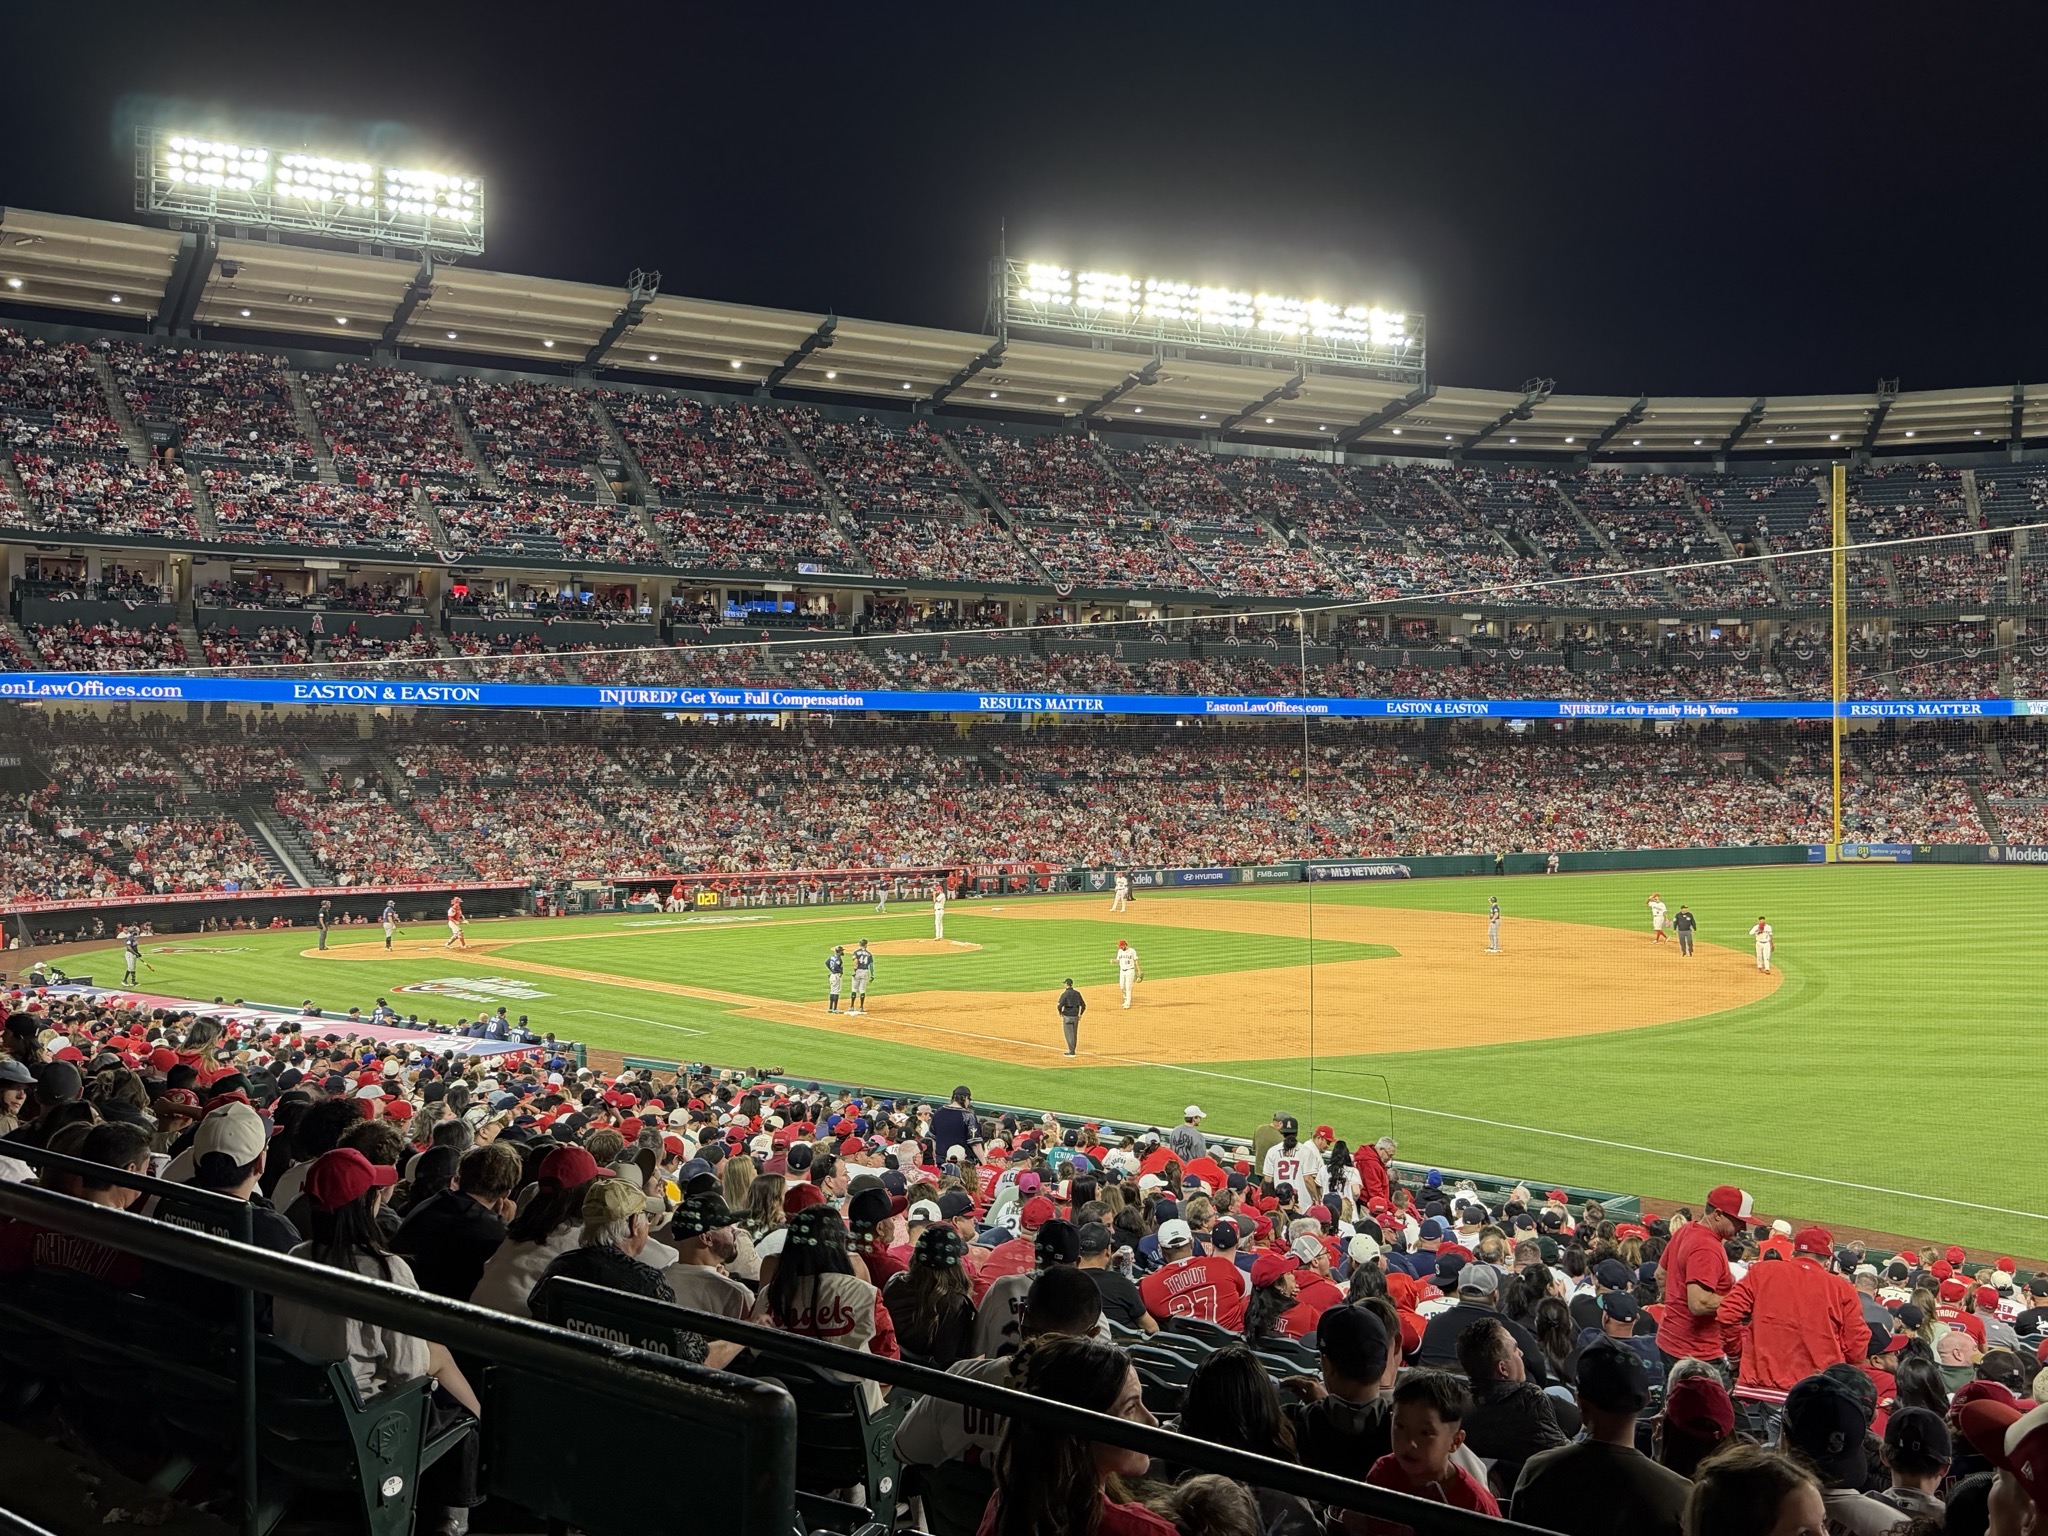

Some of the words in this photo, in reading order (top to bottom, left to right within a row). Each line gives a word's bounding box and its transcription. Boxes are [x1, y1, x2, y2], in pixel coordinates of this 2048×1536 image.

[293, 684, 378, 699] EASTON
[382, 686, 396, 699] &
[400, 686, 480, 701] EASTON
[598, 689, 678, 706] INJURED?
[680, 691, 706, 704] Get
[708, 692, 742, 704] Your
[743, 692, 770, 705] Full
[772, 695, 864, 708] Compensation
[979, 697, 1042, 710] RESULTS
[1045, 698, 1104, 710] MATTER
[1206, 701, 1328, 713] EastonLawOffices.com
[1386, 702, 1432, 713] EASTON
[1434, 703, 1443, 714] &
[1444, 703, 1489, 714] EASTON
[1850, 704, 1915, 715] RESULTS
[1918, 704, 1983, 715] MATTER
[1558, 704, 1609, 716] INJURED?
[1610, 704, 1626, 715] Let
[1627, 705, 1646, 715] Our
[1647, 704, 1682, 717] Family
[1683, 704, 1708, 717] Help
[1709, 704, 1739, 715] Yours
[1857, 846, 1869, 855] 811
[1919, 845, 1931, 854] 347
[2005, 846, 2048, 862] Modelo
[1195, 872, 1224, 880] HYUNDAI
[1331, 867, 1351, 878] MLB
[1351, 865, 1396, 877] NETWORK
[1053, 1151, 1075, 1161] ICHIRO
[1277, 1160, 1300, 1181] 27
[1163, 1266, 1208, 1295] TROUT
[1936, 1309, 1960, 1319] TROUT
